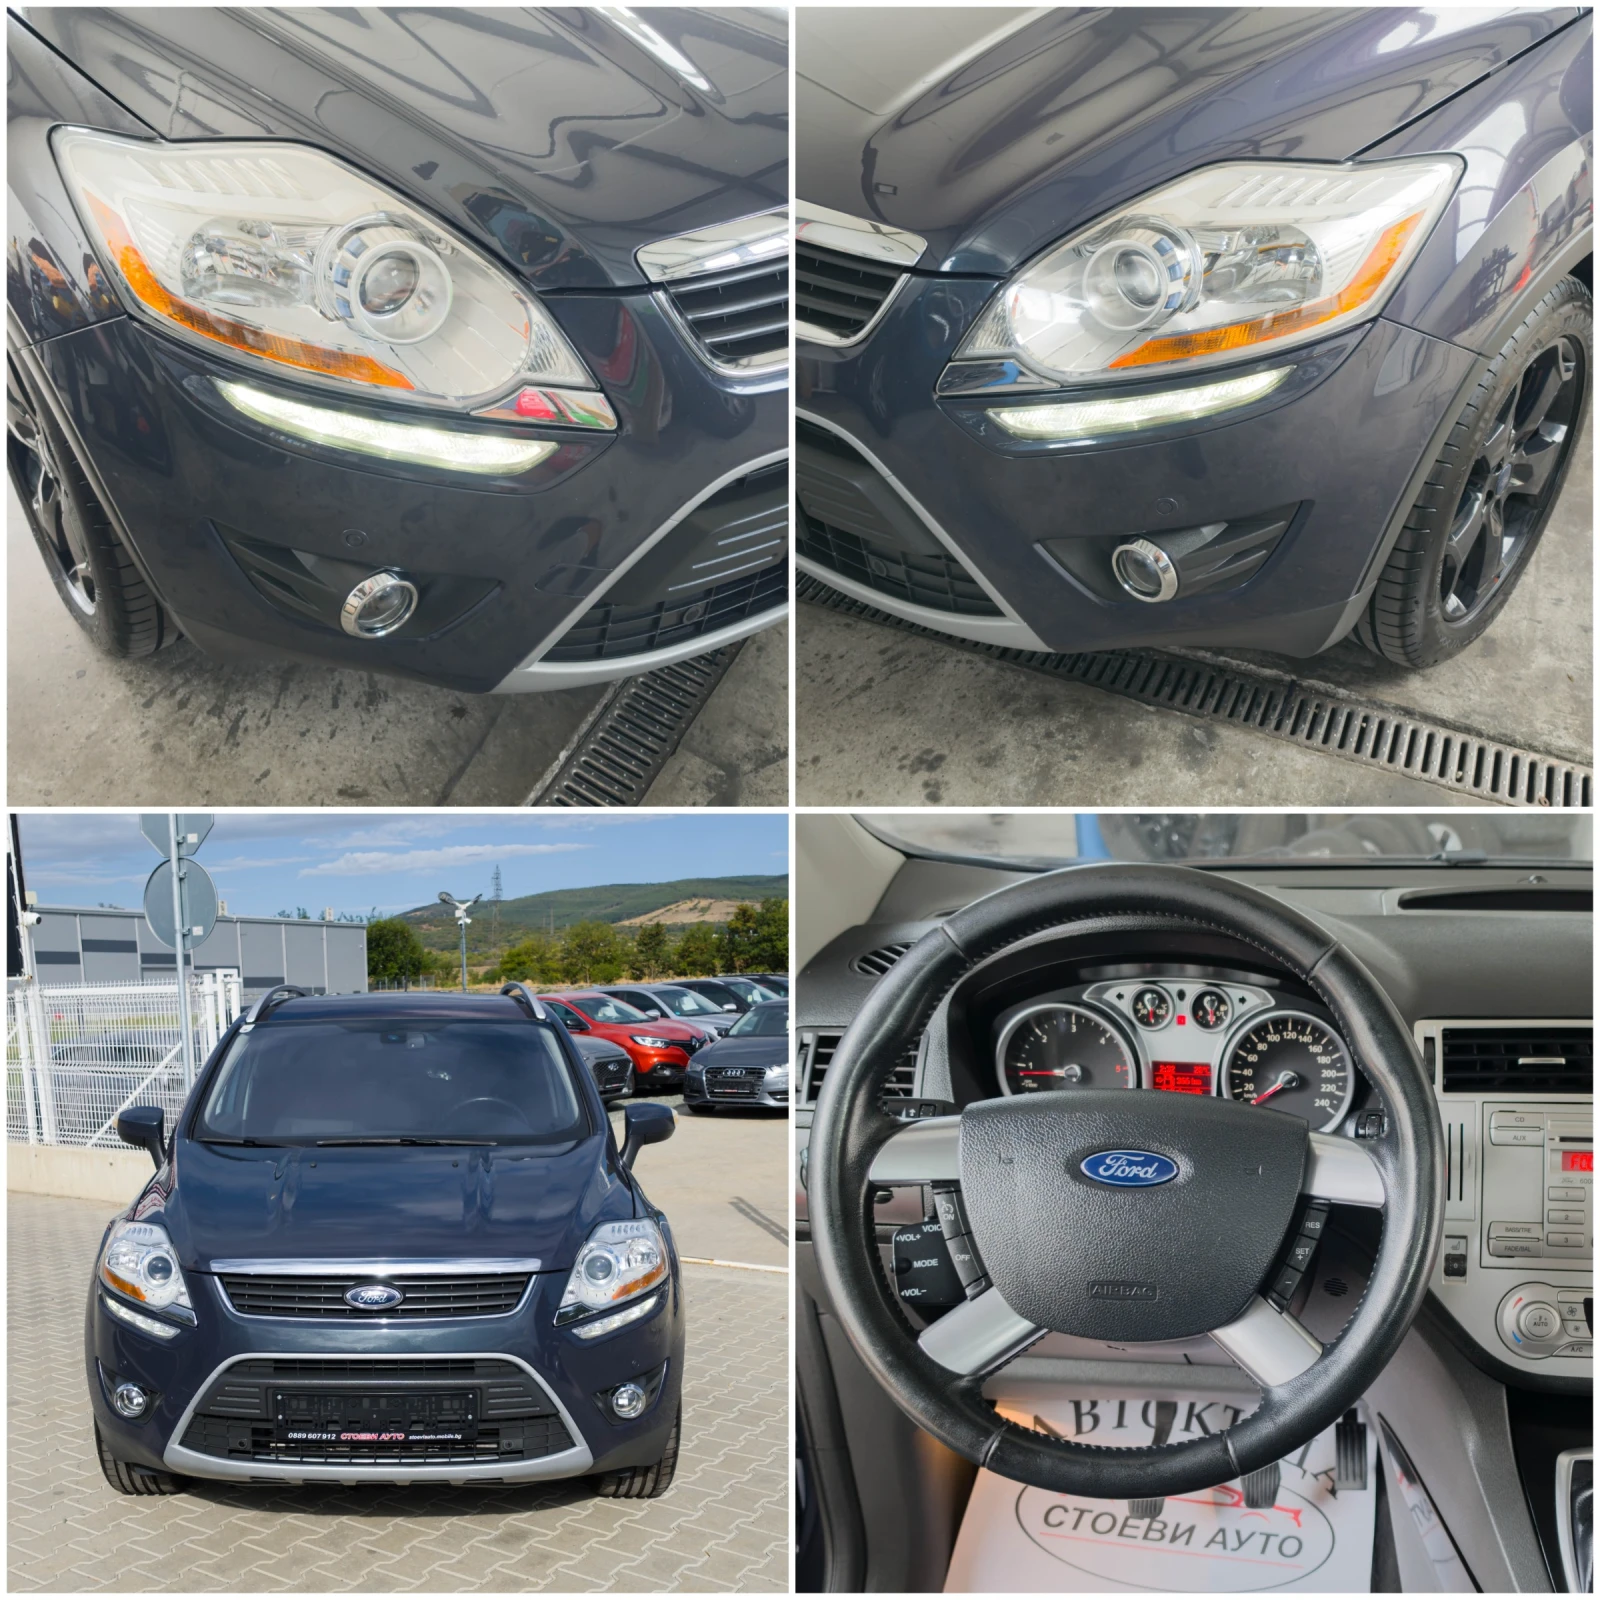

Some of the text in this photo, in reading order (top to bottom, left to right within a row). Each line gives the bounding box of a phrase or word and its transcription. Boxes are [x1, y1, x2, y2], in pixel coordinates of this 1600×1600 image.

[1071, 1025, 1077, 1033] 3
[1041, 1035, 1048, 1043] 2
[1266, 1034, 1280, 1042] 100
[1282, 1031, 1297, 1039] 120
[1298, 1035, 1313, 1043] 140
[1099, 1037, 1106, 1045] 4
[1257, 1043, 1268, 1051] 80
[1308, 1045, 1323, 1053] 160
[1247, 1054, 1258, 1062] 60
[1316, 1056, 1331, 1064] 180
[1243, 1083, 1254, 1091] 20
[1320, 1084, 1336, 1092] 220
[1314, 1099, 1330, 1107] 240
[1099, 1154, 1159, 1179] Ford
[942, 1213, 955, 1221] ON
[922, 1223, 943, 1233] VOIC
[1305, 1221, 1321, 1229] RES
[1295, 1247, 1310, 1255] SET
[913, 1258, 939, 1268] MODE
[1092, 1285, 1153, 1296] AIRBAG
[358, 1290, 388, 1303] Ford
[1570, 1345, 1584, 1353] A/C
[307, 1432, 322, 1440] 607
[1043, 1504, 1303, 1559] СТОЕВИ АУТО
